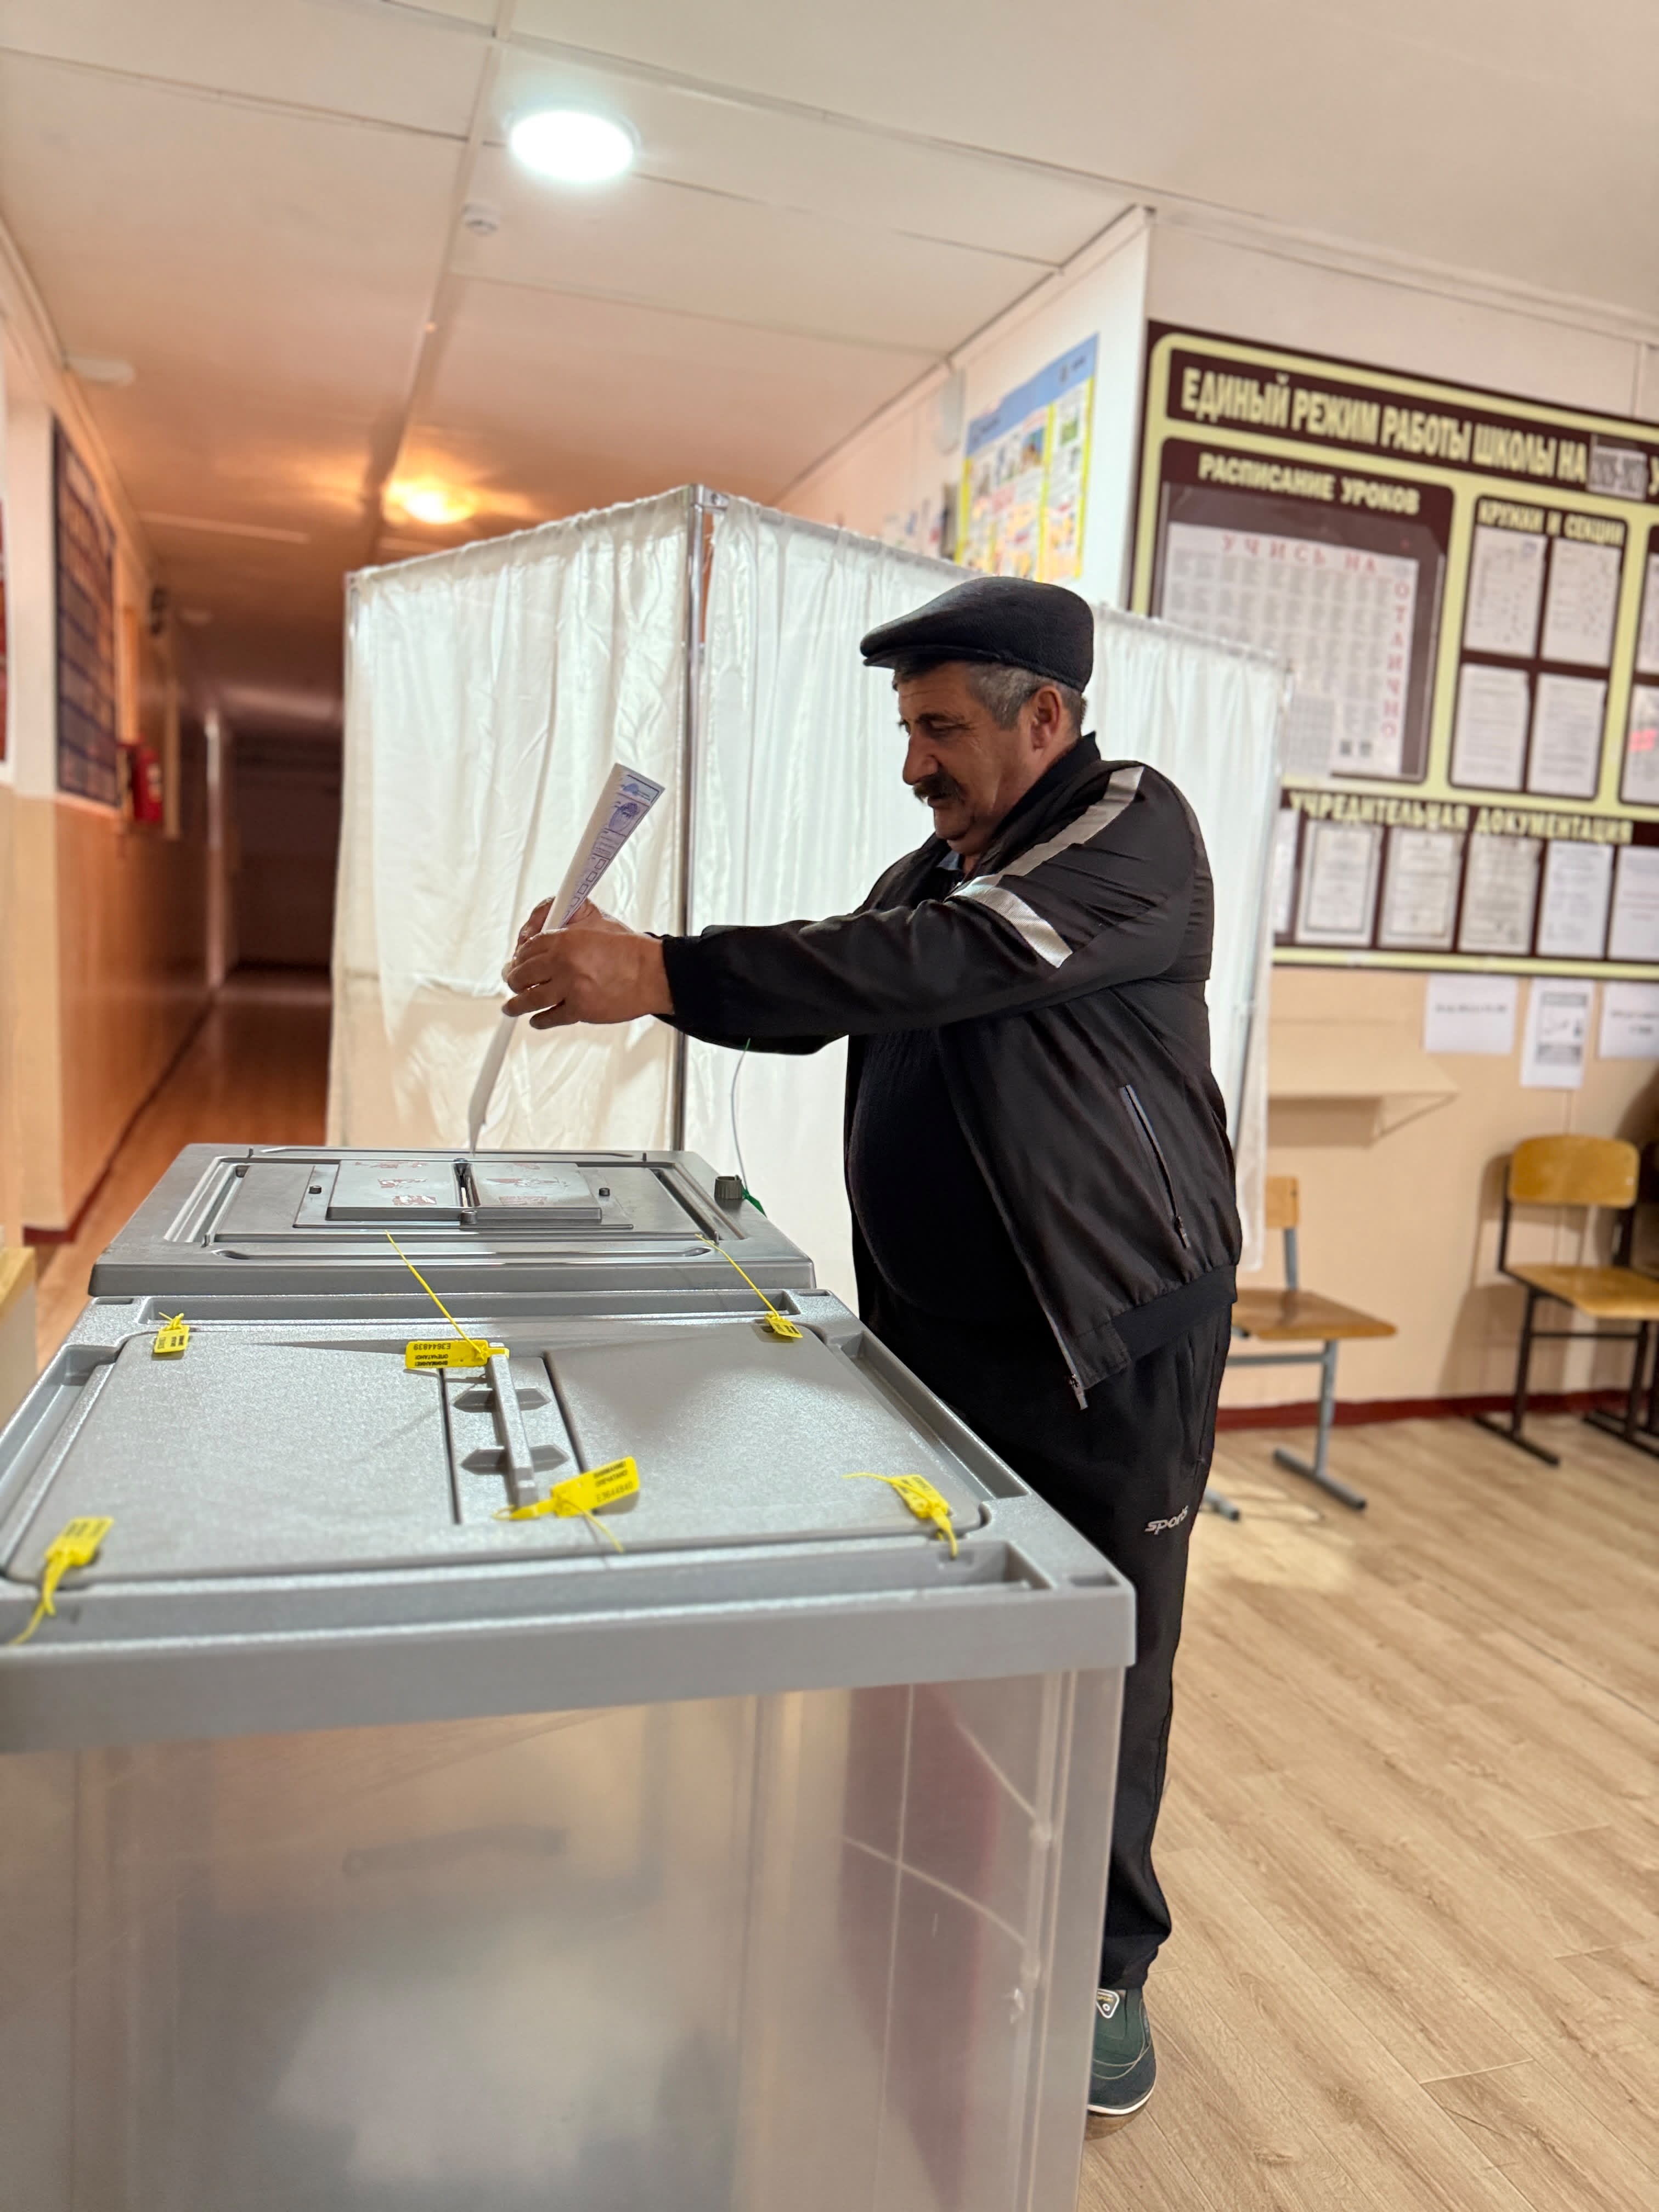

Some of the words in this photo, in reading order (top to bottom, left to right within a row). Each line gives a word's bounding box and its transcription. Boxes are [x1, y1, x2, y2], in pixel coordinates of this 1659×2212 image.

[1181, 366, 1290, 428] ЕДИНЫЙ
[1291, 387, 1380, 445] РЕЖИМ
[1380, 405, 1472, 462] РАБОТЫ
[1472, 423, 1557, 477] ШКОЛЫ
[1557, 439, 1587, 483] НА
[1198, 452, 1336, 501] РАСПИСАНИЕ
[1340, 476, 1420, 515] УРОКОВ
[1478, 499, 1545, 533] КРУЖКИ
[1546, 509, 1562, 536] И
[1565, 512, 1626, 547] СЕКЦИИ
[1290, 792, 1470, 831] УЧРЕДИТЕЛЬНАЯ
[1474, 806, 1633, 845] ДОКУМЕНТАЦИЯ
